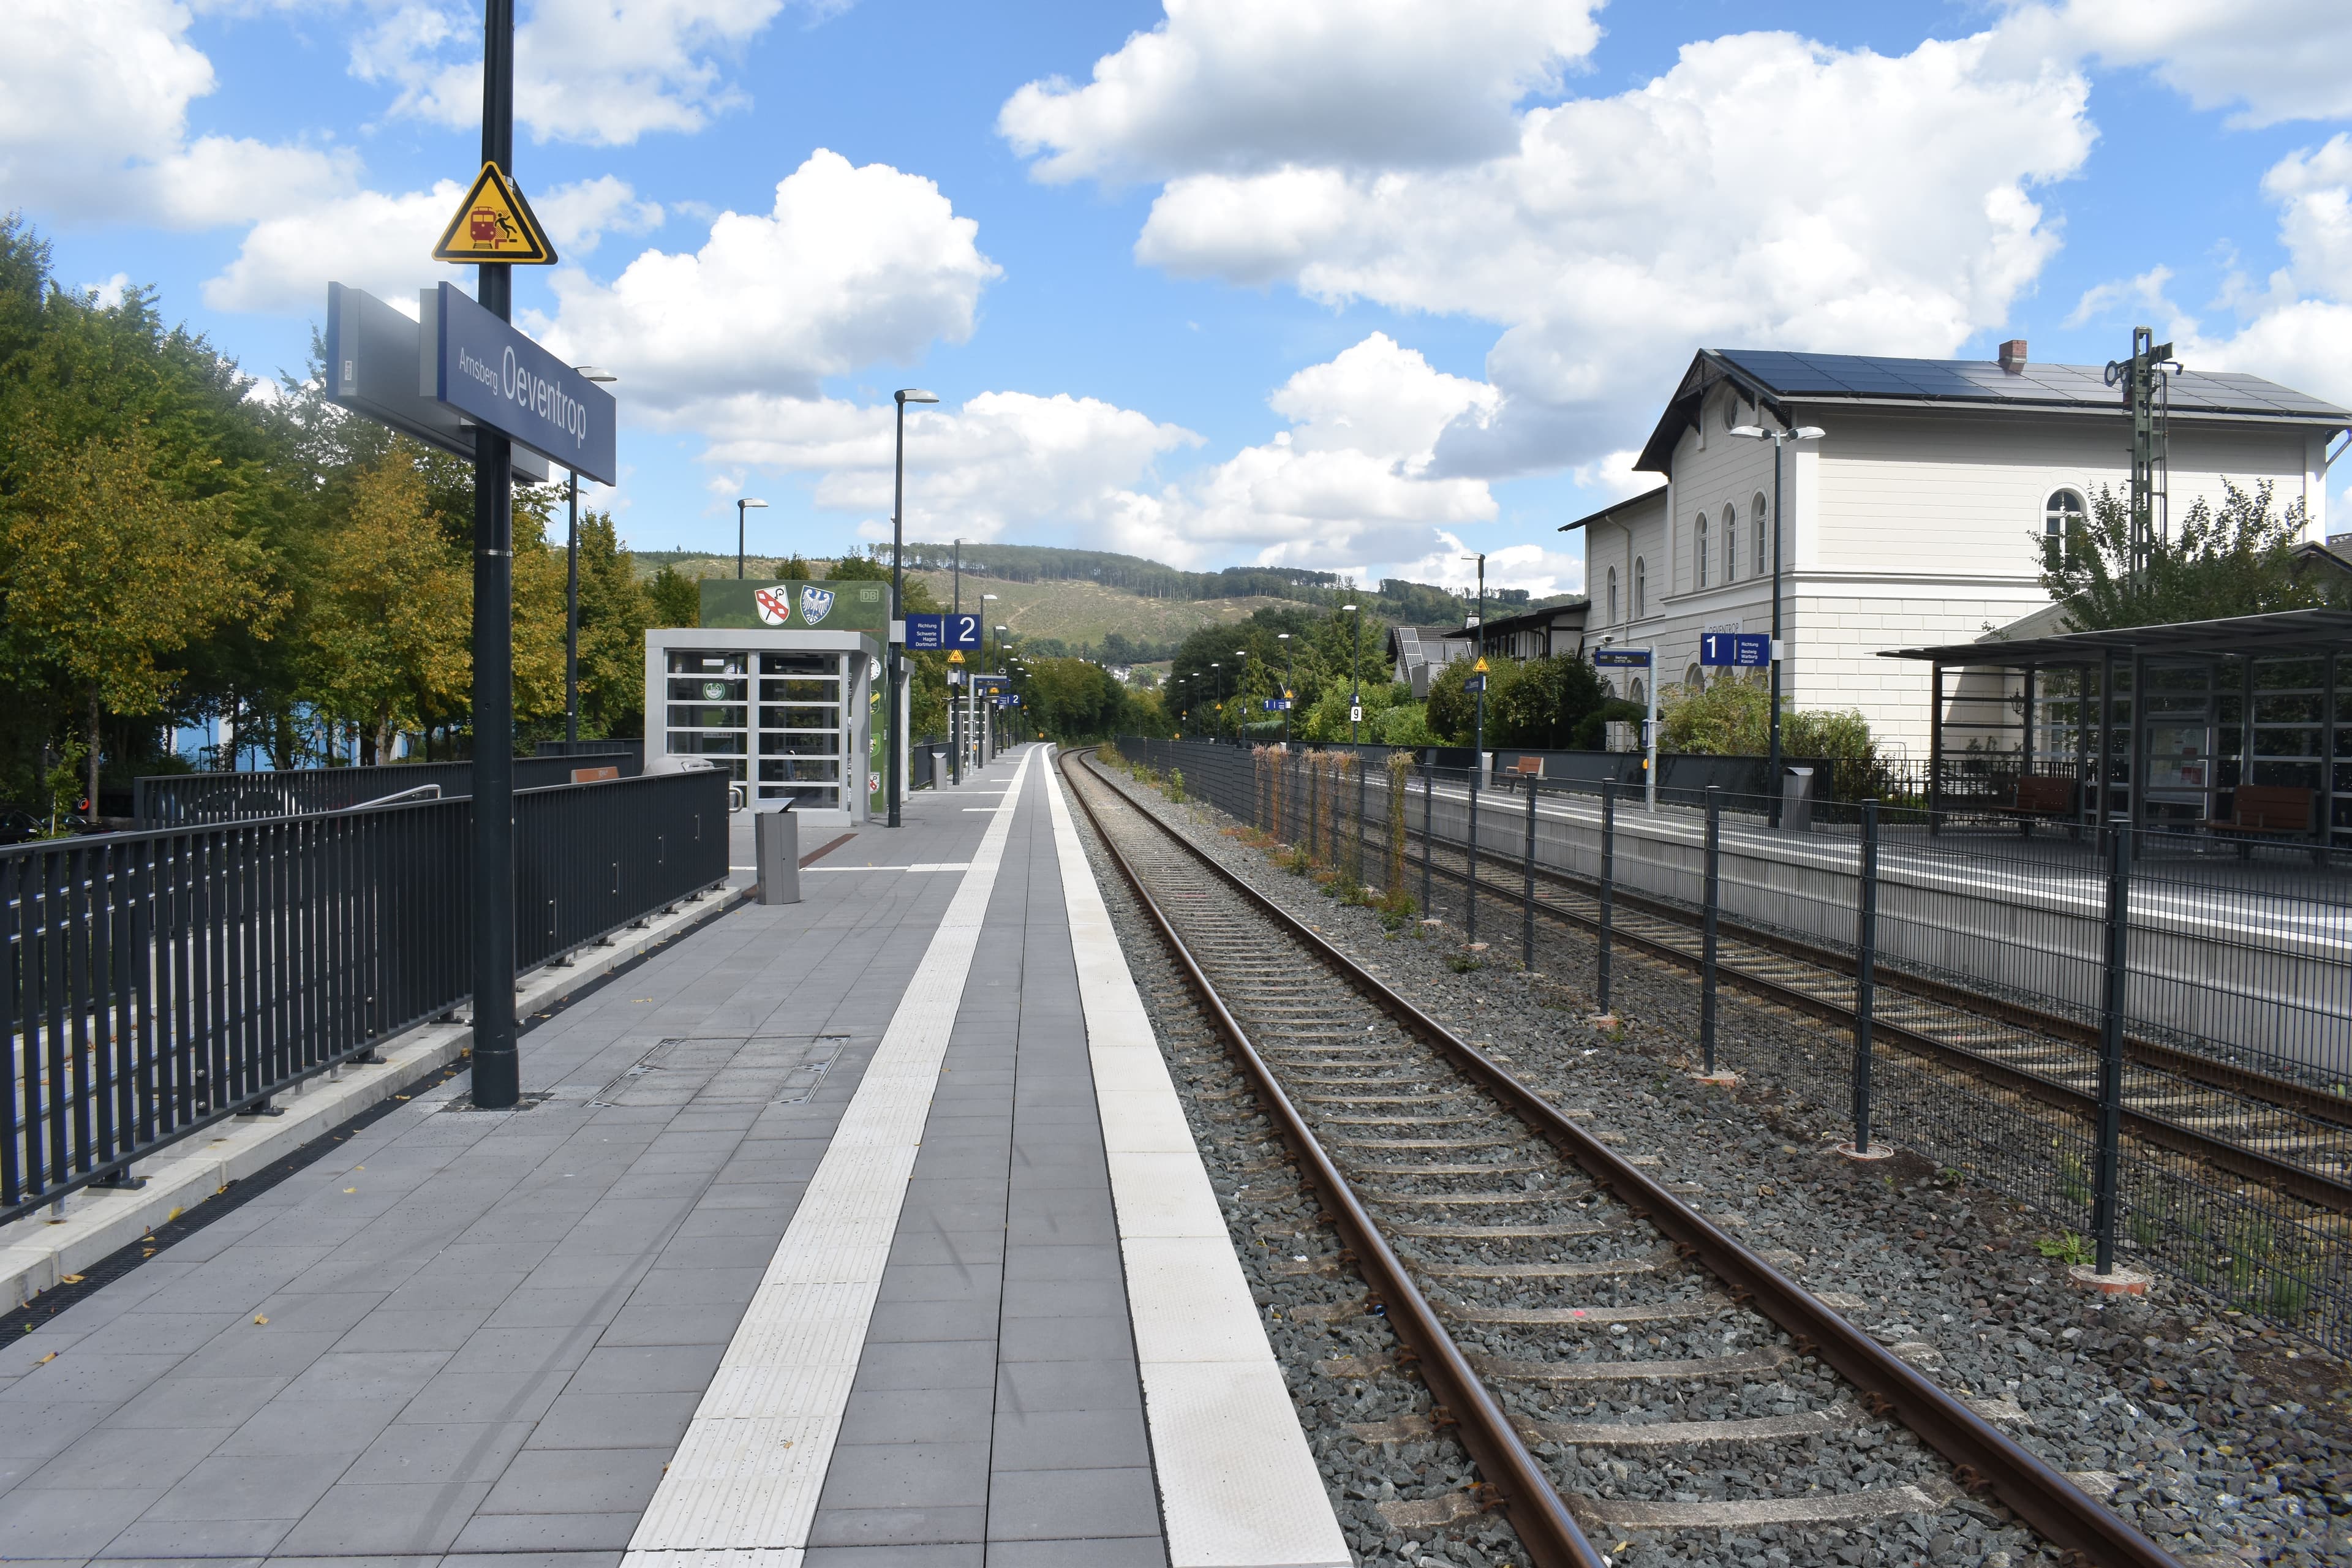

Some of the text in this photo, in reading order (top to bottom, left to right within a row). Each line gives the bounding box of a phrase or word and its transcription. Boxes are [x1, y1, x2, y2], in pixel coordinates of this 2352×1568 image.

[459, 345, 586, 449] Arnsberg Oeventrop
[862, 591, 877, 600] DB
[959, 617, 975, 641] 2
[1706, 636, 1716, 658] 1
[1013, 695, 1019, 703] 2
[1354, 709, 1359, 719] 9
